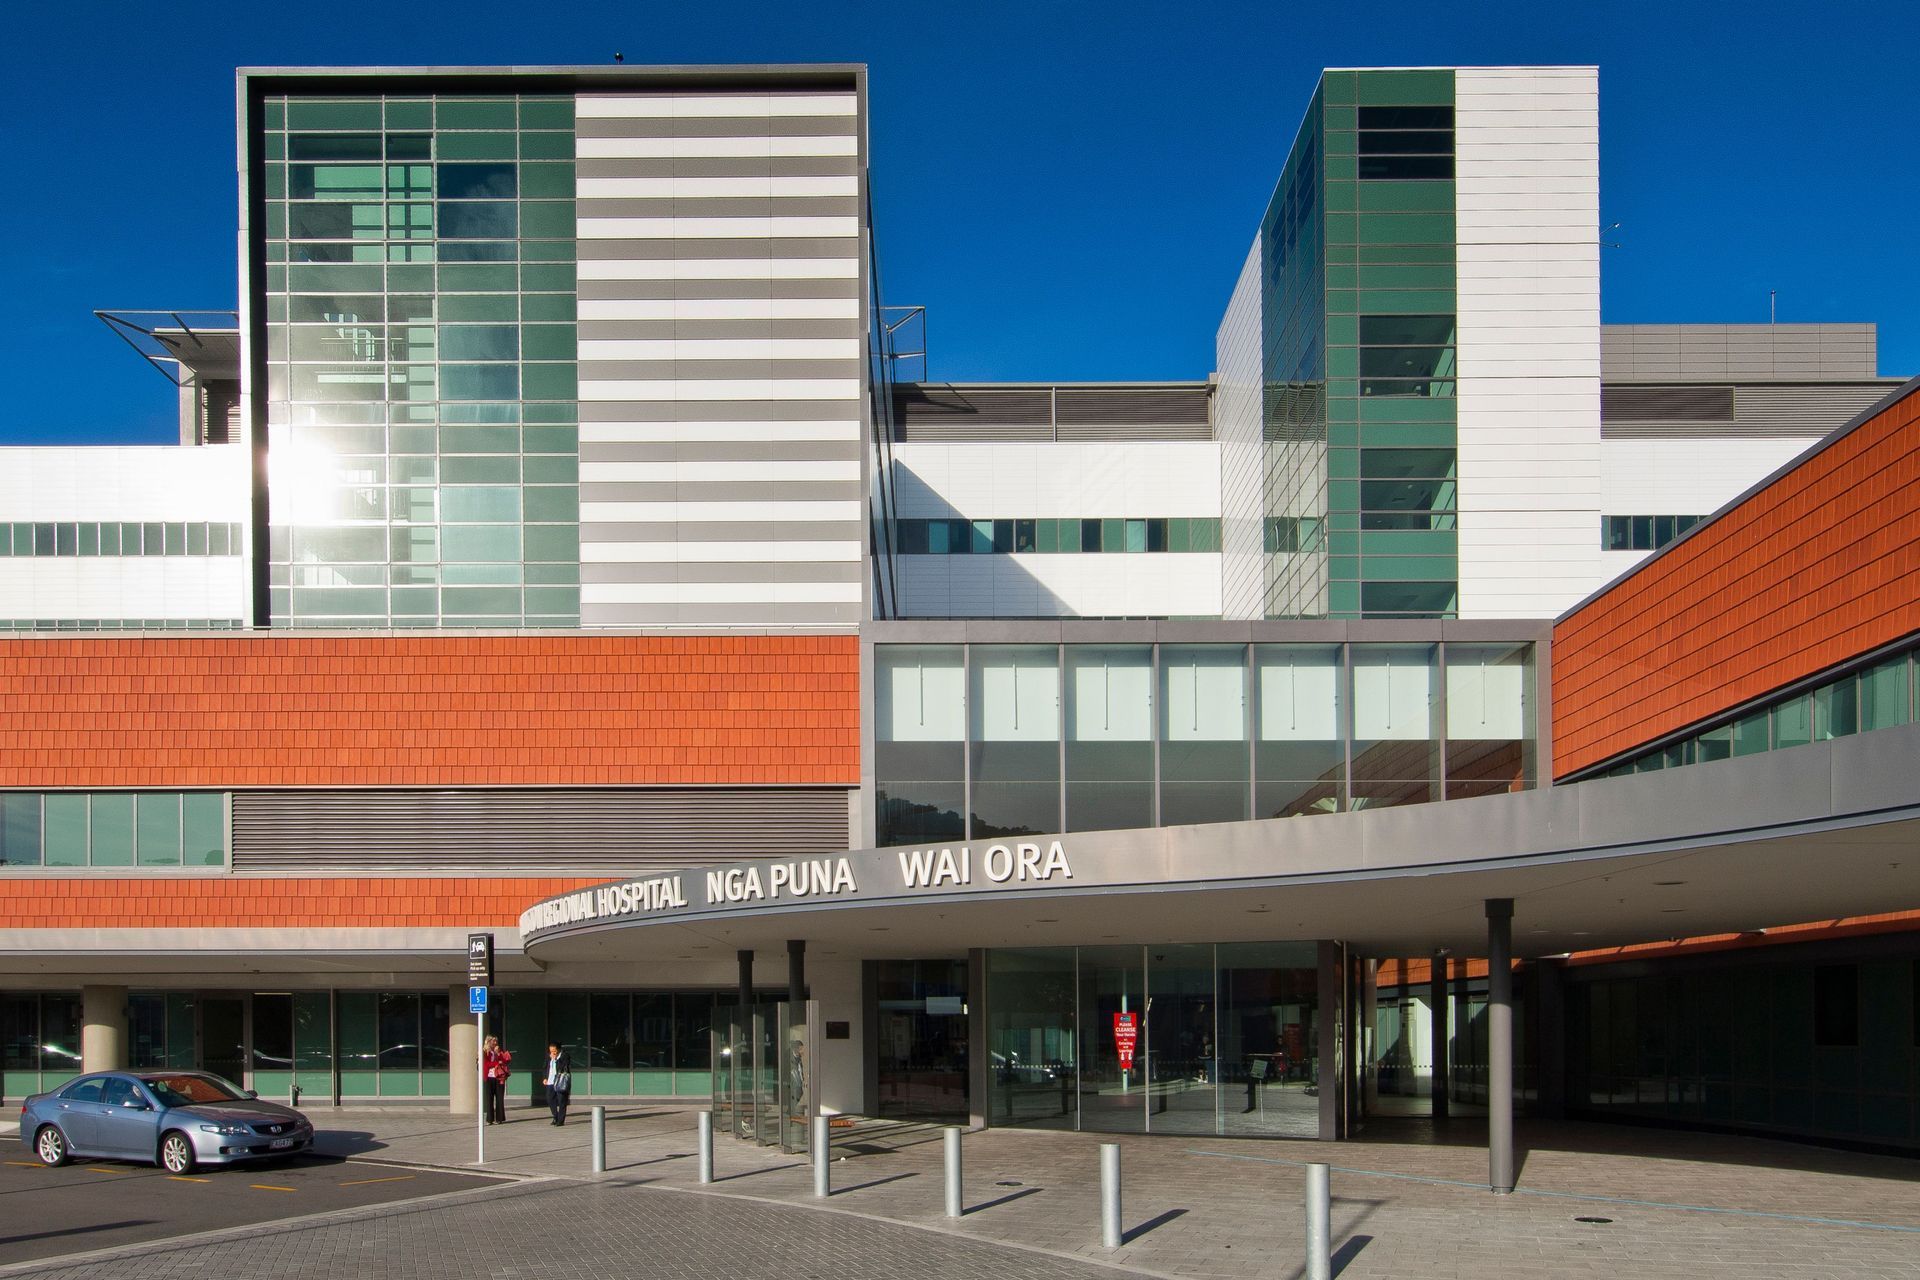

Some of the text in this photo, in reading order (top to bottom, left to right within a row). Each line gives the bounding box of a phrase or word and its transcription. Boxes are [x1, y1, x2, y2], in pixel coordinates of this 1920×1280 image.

[543, 891, 597, 926] REGIONAL
[597, 876, 688, 917] HOSPITAL
[706, 868, 766, 904] NGA
[770, 857, 858, 897] PUNA
[899, 847, 970, 887] WAI
[983, 840, 1073, 883] ORA
[476, 988, 481, 996] P
